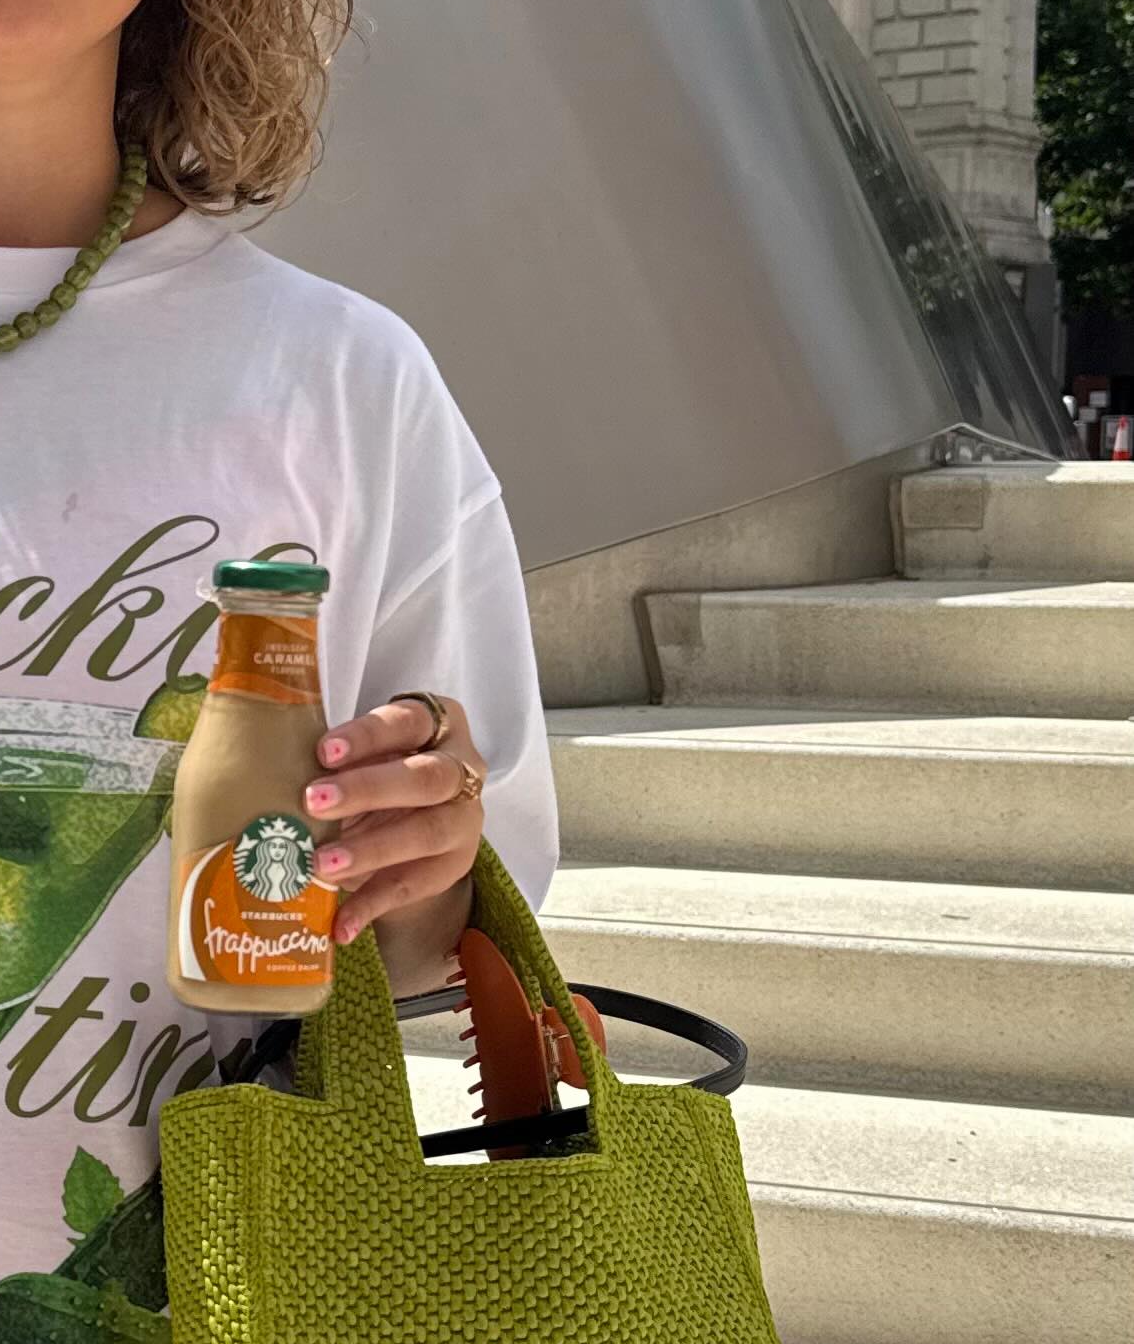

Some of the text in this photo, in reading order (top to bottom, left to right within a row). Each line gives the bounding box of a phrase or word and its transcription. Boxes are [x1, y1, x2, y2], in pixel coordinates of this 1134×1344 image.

[252, 651, 316, 666] CARAMEL
[241, 910, 304, 921] STARBUCKS
[203, 897, 330, 975] frappuccino
